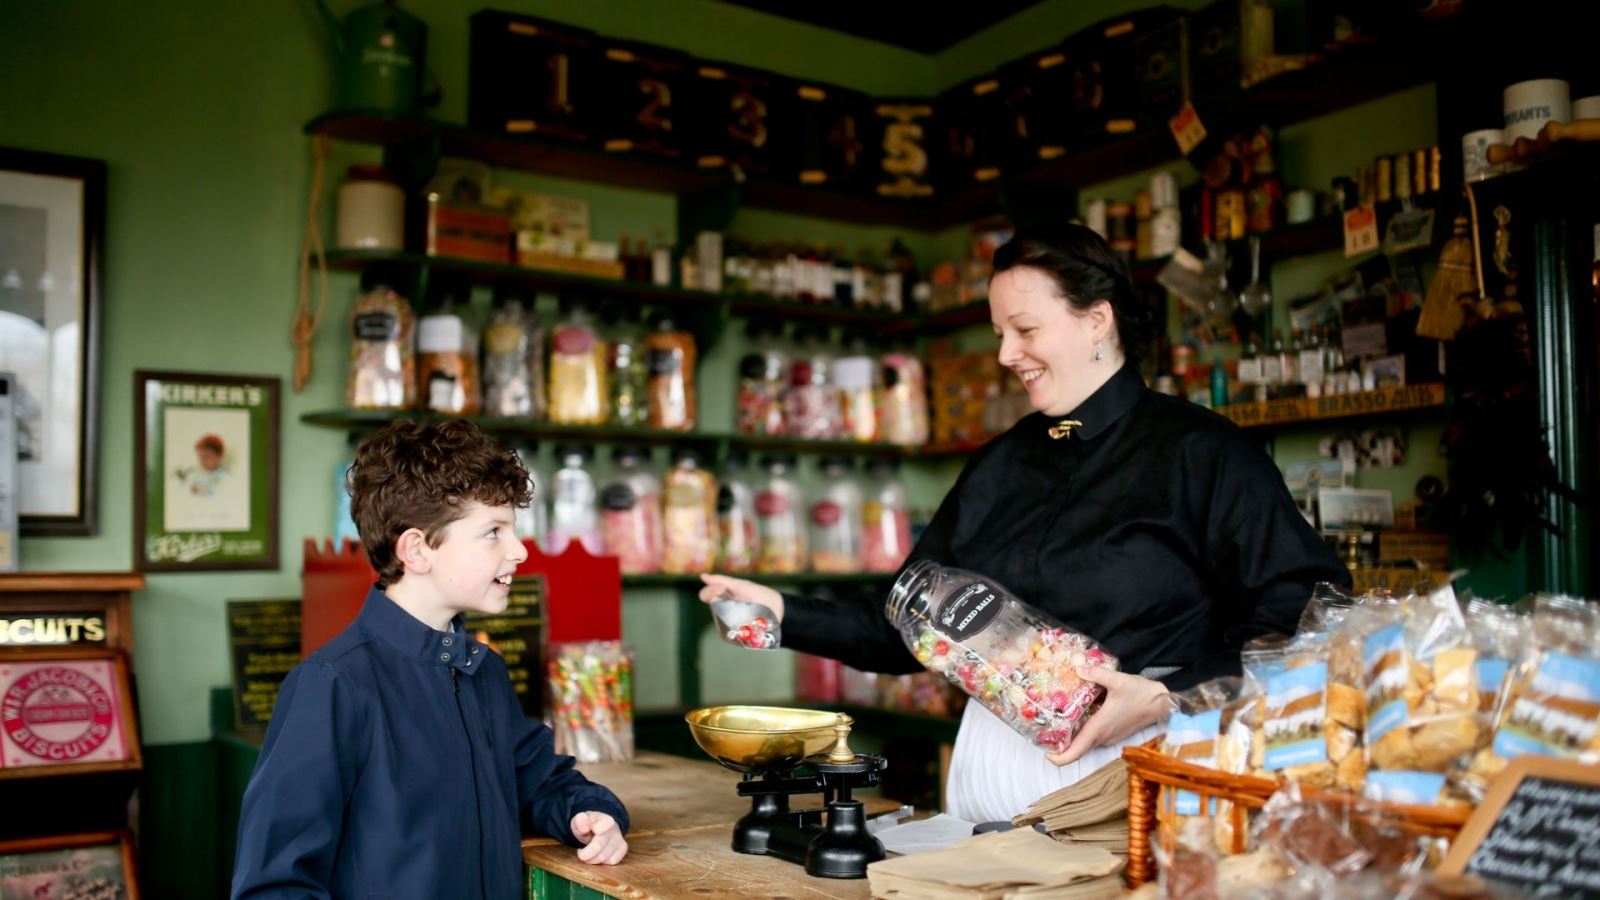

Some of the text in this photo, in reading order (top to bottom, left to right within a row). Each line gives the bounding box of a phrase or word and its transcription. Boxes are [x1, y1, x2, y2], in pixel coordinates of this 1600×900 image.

[545, 52, 573, 114] 1
[635, 77, 673, 132] 2
[726, 95, 770, 149] 3
[880, 121, 930, 178] 5
[157, 383, 261, 406] KIRKER'S
[1318, 393, 1386, 413] BRASSO
[956, 609, 979, 632] MIXED
[975, 593, 996, 612] BALLS
[11, 723, 107, 759] BISCUITS
